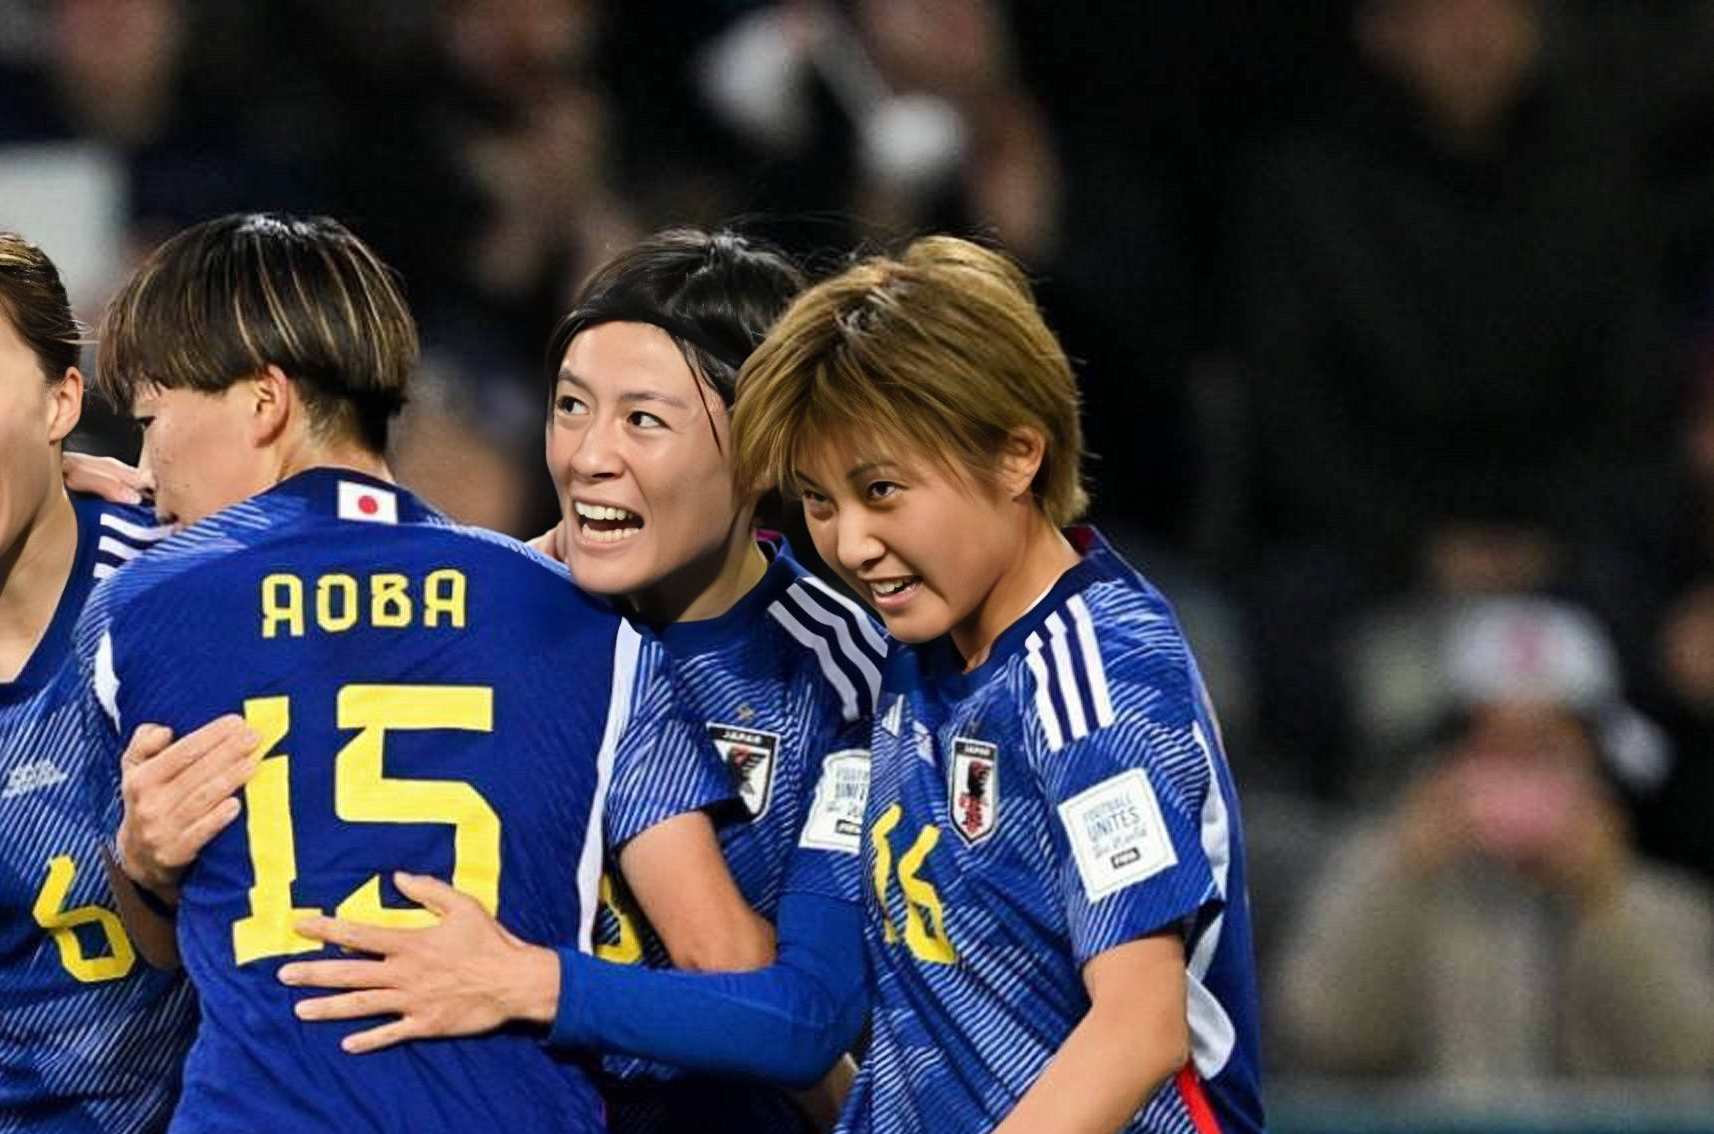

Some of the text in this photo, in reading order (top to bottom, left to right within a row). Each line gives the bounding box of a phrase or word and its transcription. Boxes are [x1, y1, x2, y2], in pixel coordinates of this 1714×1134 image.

[260, 569, 467, 638] AOBA
[232, 684, 501, 966] 15
[871, 804, 958, 964] 16
[32, 853, 136, 983] 6
